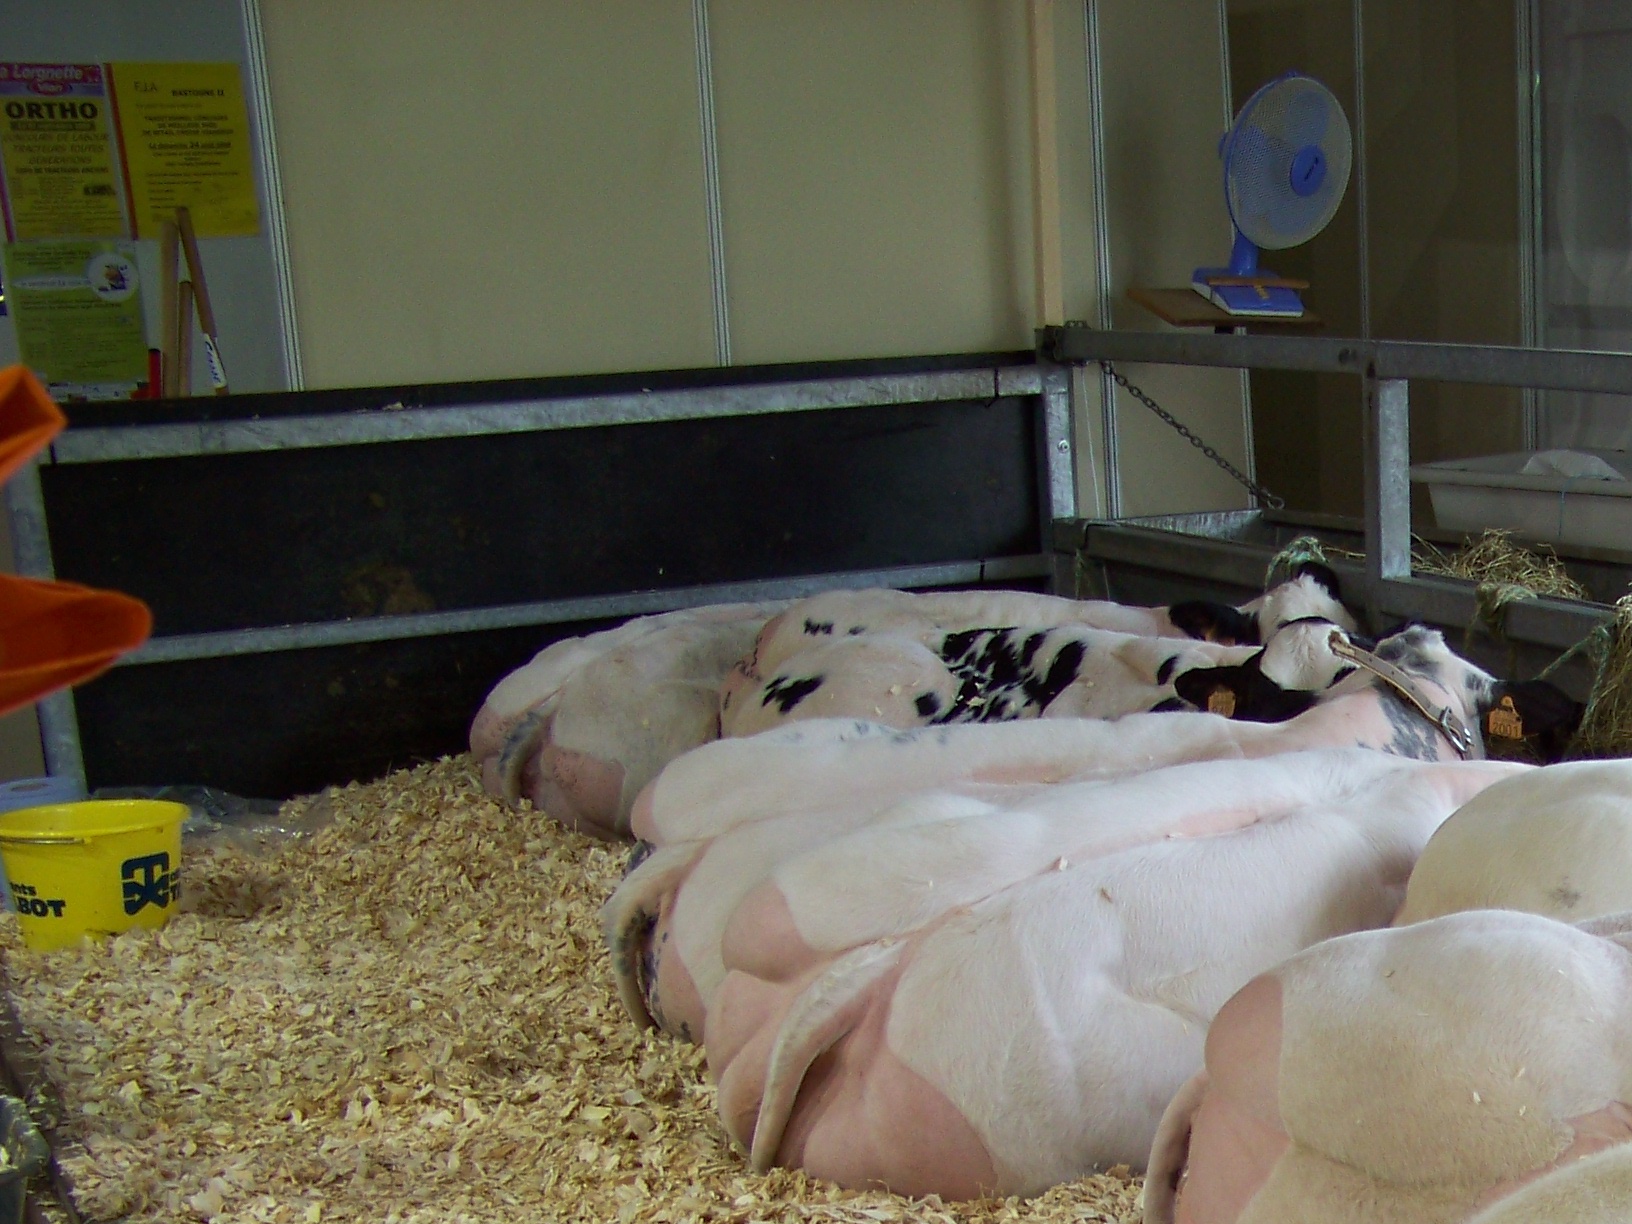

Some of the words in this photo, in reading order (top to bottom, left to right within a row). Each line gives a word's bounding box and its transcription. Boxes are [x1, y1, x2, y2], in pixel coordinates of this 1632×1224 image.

[172, 89, 214, 97] BASTOGNE
[5, 101, 98, 119] ORTHO
[13, 144, 67, 154] TRACTEURS
